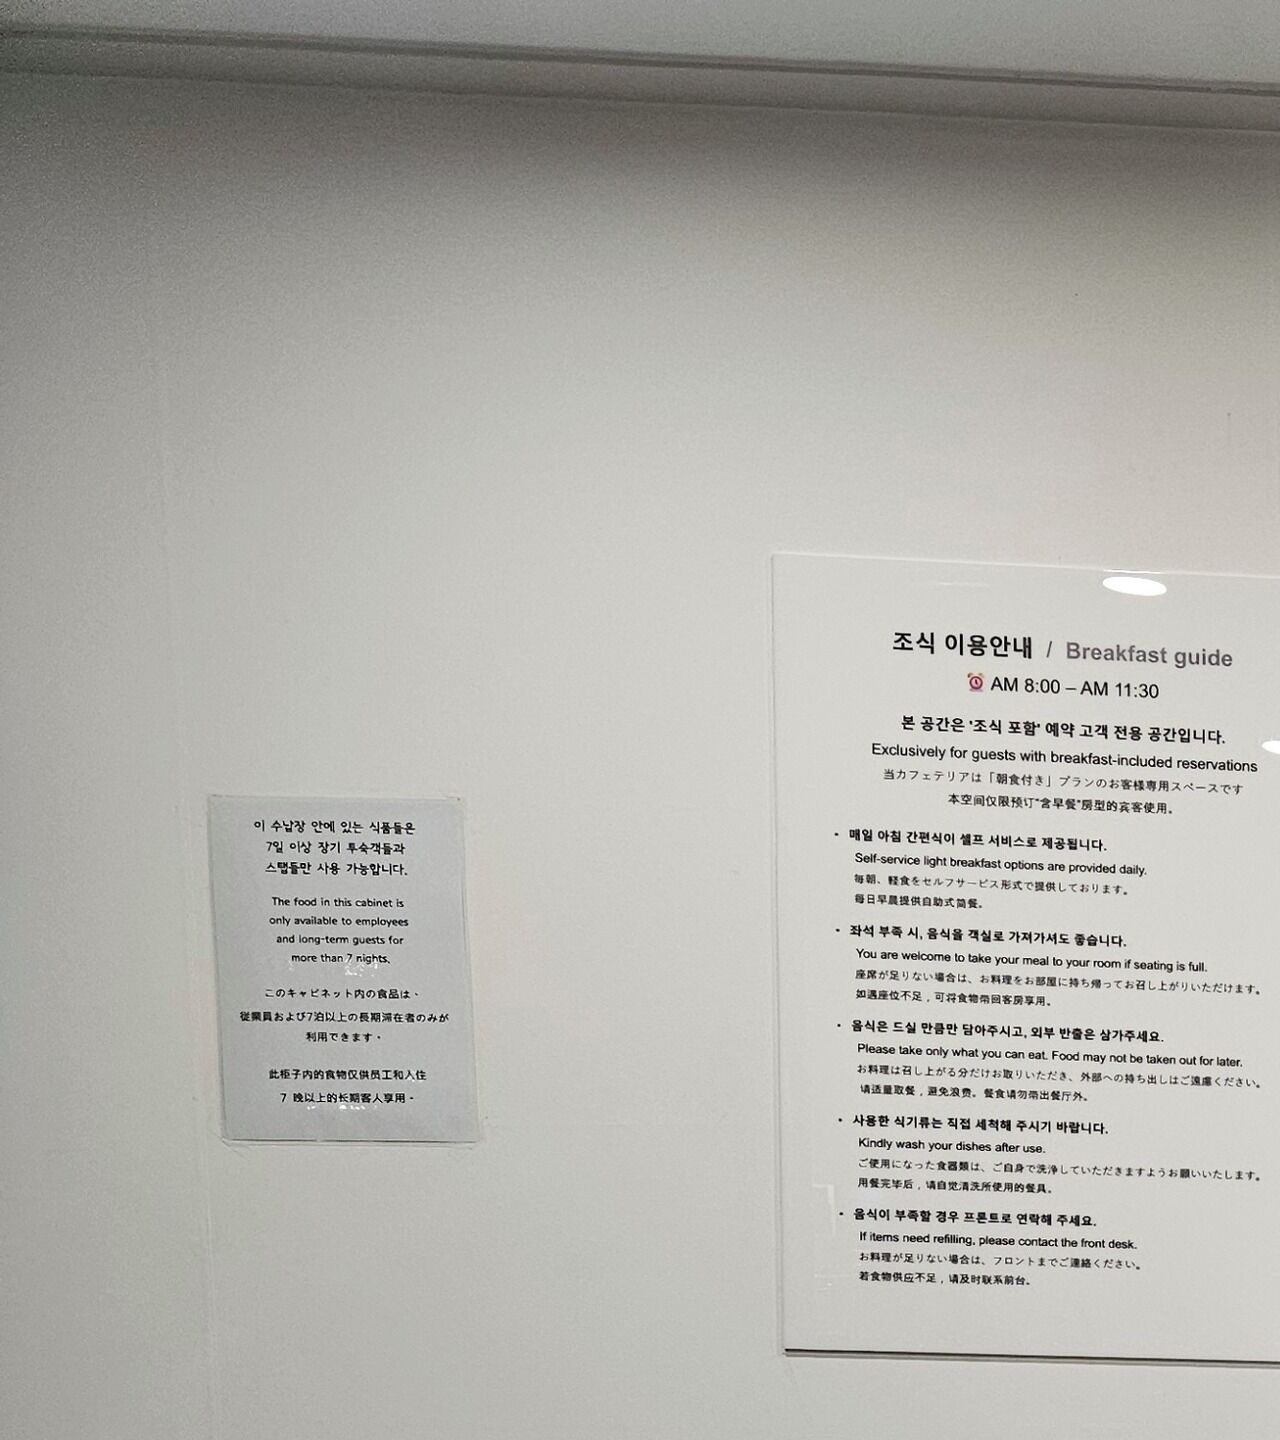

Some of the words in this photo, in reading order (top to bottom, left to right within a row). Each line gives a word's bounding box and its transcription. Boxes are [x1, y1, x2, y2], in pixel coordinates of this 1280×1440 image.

[892, 632, 935, 655] 조식
[945, 633, 1032, 659] 이용안내
[1066, 642, 1167, 664] Breakfast
[1174, 648, 1232, 669] guide
[990, 676, 1018, 692] AM
[1024, 678, 1060, 694] 8:00
[1080, 680, 1108, 696] AM
[1115, 682, 1159, 699] 11:30
[900, 715, 915, 731] 본
[920, 716, 965, 733] 공간은
[969, 720, 1002, 735] '조식
[1008, 721, 1040, 736] 포함'
[1045, 722, 1075, 738] 예약
[1079, 724, 1108, 740] 고객
[1114, 725, 1143, 741] 전용
[1148, 727, 1226, 745] 공간입니다.
[872, 743, 946, 761] Exclusively
[950, 746, 968, 759] for
[972, 749, 1016, 762] guests
[1019, 750, 1048, 762] with
[1051, 750, 1172, 768] breakfast-included
[1177, 759, 1258, 772] reservations
[254, 819, 265, 832] 이
[270, 820, 306, 833] 수납장
[311, 820, 335, 833] 안에
[338, 821, 364, 834] 있는
[369, 821, 416, 835] 식품들은
[266, 841, 283, 854] 7일
[290, 841, 312, 854] 이상
[318, 841, 340, 855] 장기
[346, 842, 406, 855] 투숙객들과
[849, 828, 873, 842] 매일
[878, 830, 901, 843] 아침
[906, 831, 955, 846] 간편식이
[960, 833, 984, 846] 셀프
[988, 834, 1038, 848] 서비스로
[1041, 837, 1107, 852] 제공됩니다.
[265, 862, 312, 875] 스탭들만
[317, 862, 341, 875] 사용
[346, 863, 408, 876] 가능합니다.
[855, 850, 920, 865] Self-service
[924, 856, 948, 868] light
[950, 856, 1003, 869] breakfast
[1004, 860, 1044, 872] options
[1047, 863, 1066, 872] are
[1069, 863, 1116, 874] provided
[1119, 864, 1147, 877] daily.
[272, 897, 290, 906] The
[293, 896, 317, 906] food
[320, 897, 330, 906] in
[334, 898, 352, 907] this
[355, 896, 393, 907] cabinet
[396, 898, 404, 907] is
[269, 915, 291, 927] only
[294, 916, 338, 928] available
[341, 917, 352, 926] to
[355, 917, 409, 928] employees
[276, 934, 298, 944] and
[299, 934, 349, 945] long-term
[352, 936, 385, 946] guests
[388, 935, 404, 944] for
[292, 953, 318, 964] more
[320, 953, 343, 962] than
[347, 953, 353, 963] 7
[355, 953, 390, 965] nights.
[853, 1208, 890, 1221] 음식이
[894, 1209, 932, 1223] 부족할
[935, 1211, 959, 1223] 경우
[963, 1212, 1012, 1224] 프론트로
[1016, 1213, 1052, 1226] 연락해
[1056, 1214, 1096, 1227] 주세요.
[860, 1231, 868, 1241] If
[870, 1232, 899, 1242] items
[903, 1233, 930, 1243] need
[933, 1234, 975, 1246] refilling,
[979, 1235, 1016, 1247] please
[1018, 1235, 1059, 1245] contact
[1061, 1237, 1078, 1247] the
[1081, 1238, 1105, 1248] front
[1108, 1239, 1138, 1249] desk.
